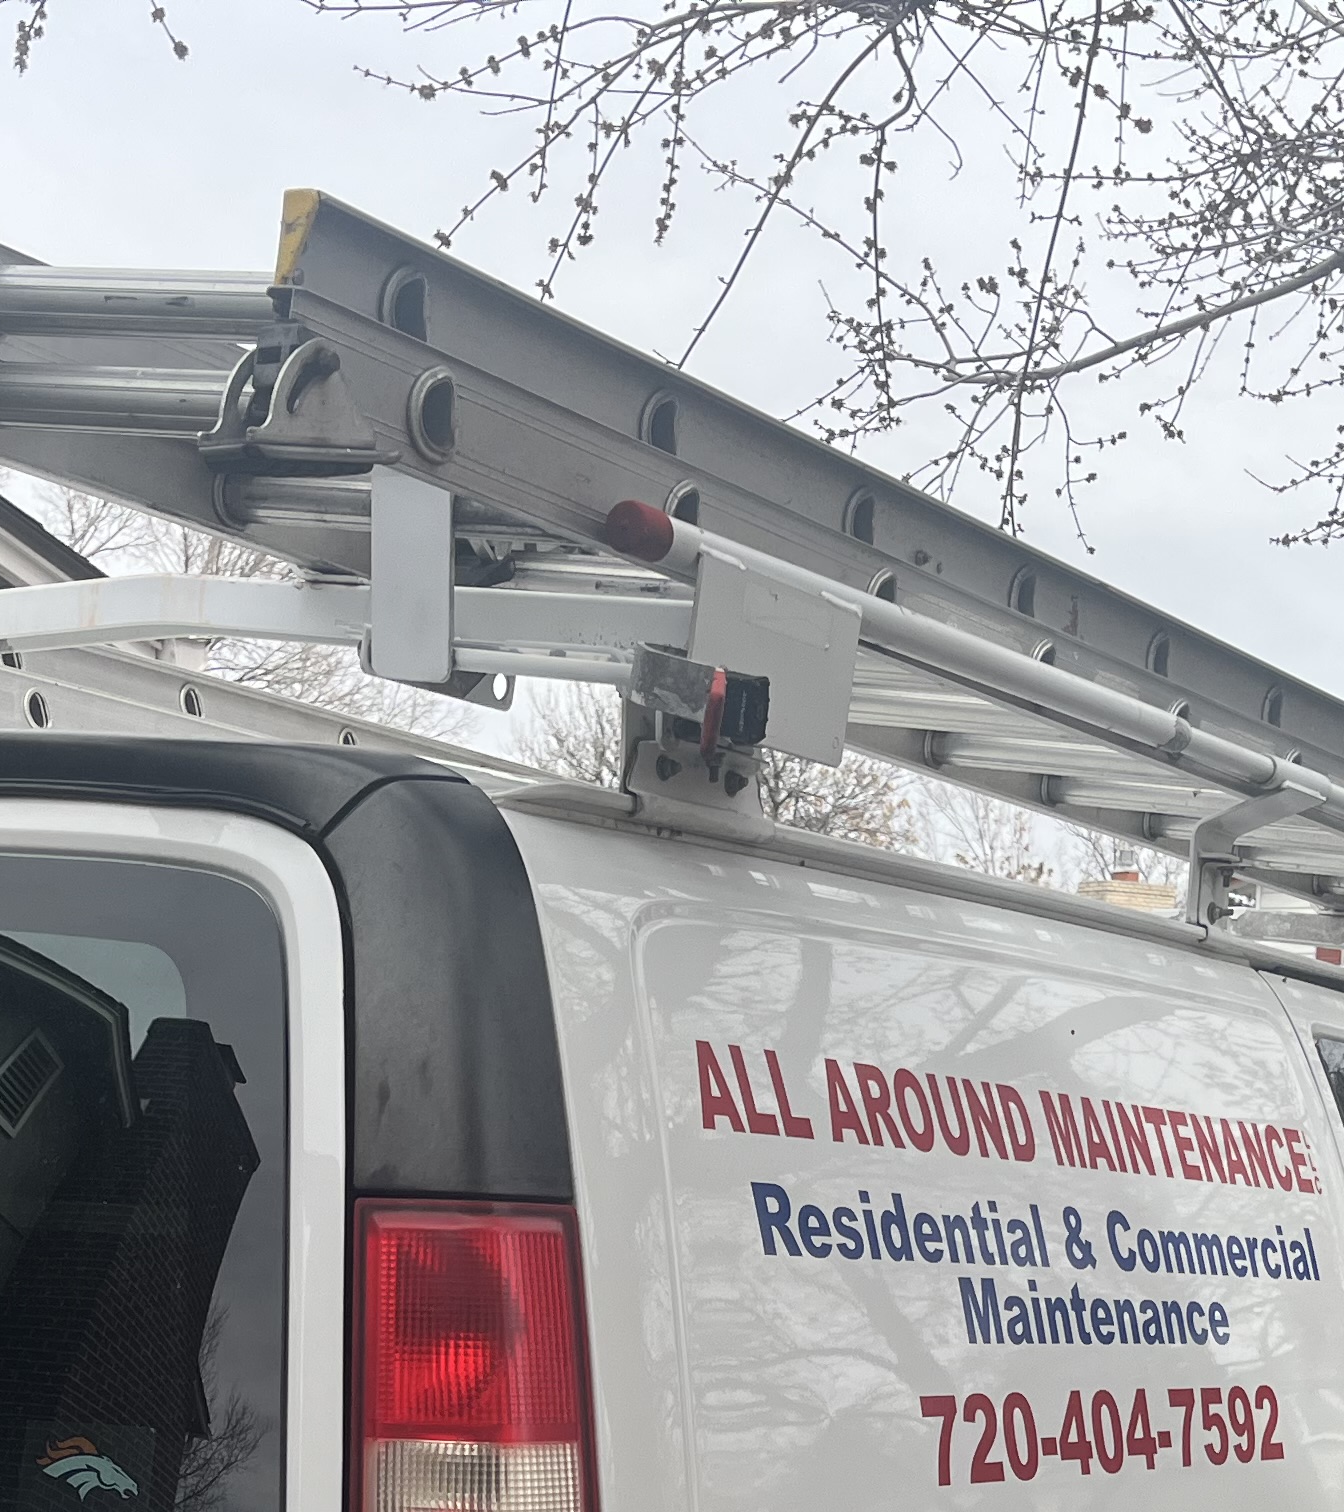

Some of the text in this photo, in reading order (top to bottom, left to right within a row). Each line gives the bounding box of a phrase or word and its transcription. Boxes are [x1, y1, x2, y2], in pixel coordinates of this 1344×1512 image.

[695, 1040, 1314, 1194] ALL AROUND MAINTENANCE
[1301, 1130, 1323, 1195] LLC
[750, 1181, 1321, 1282] Residential & Commercial
[958, 1276, 1231, 1345] Maintenance
[919, 1384, 1285, 1487] 720-404-7592
